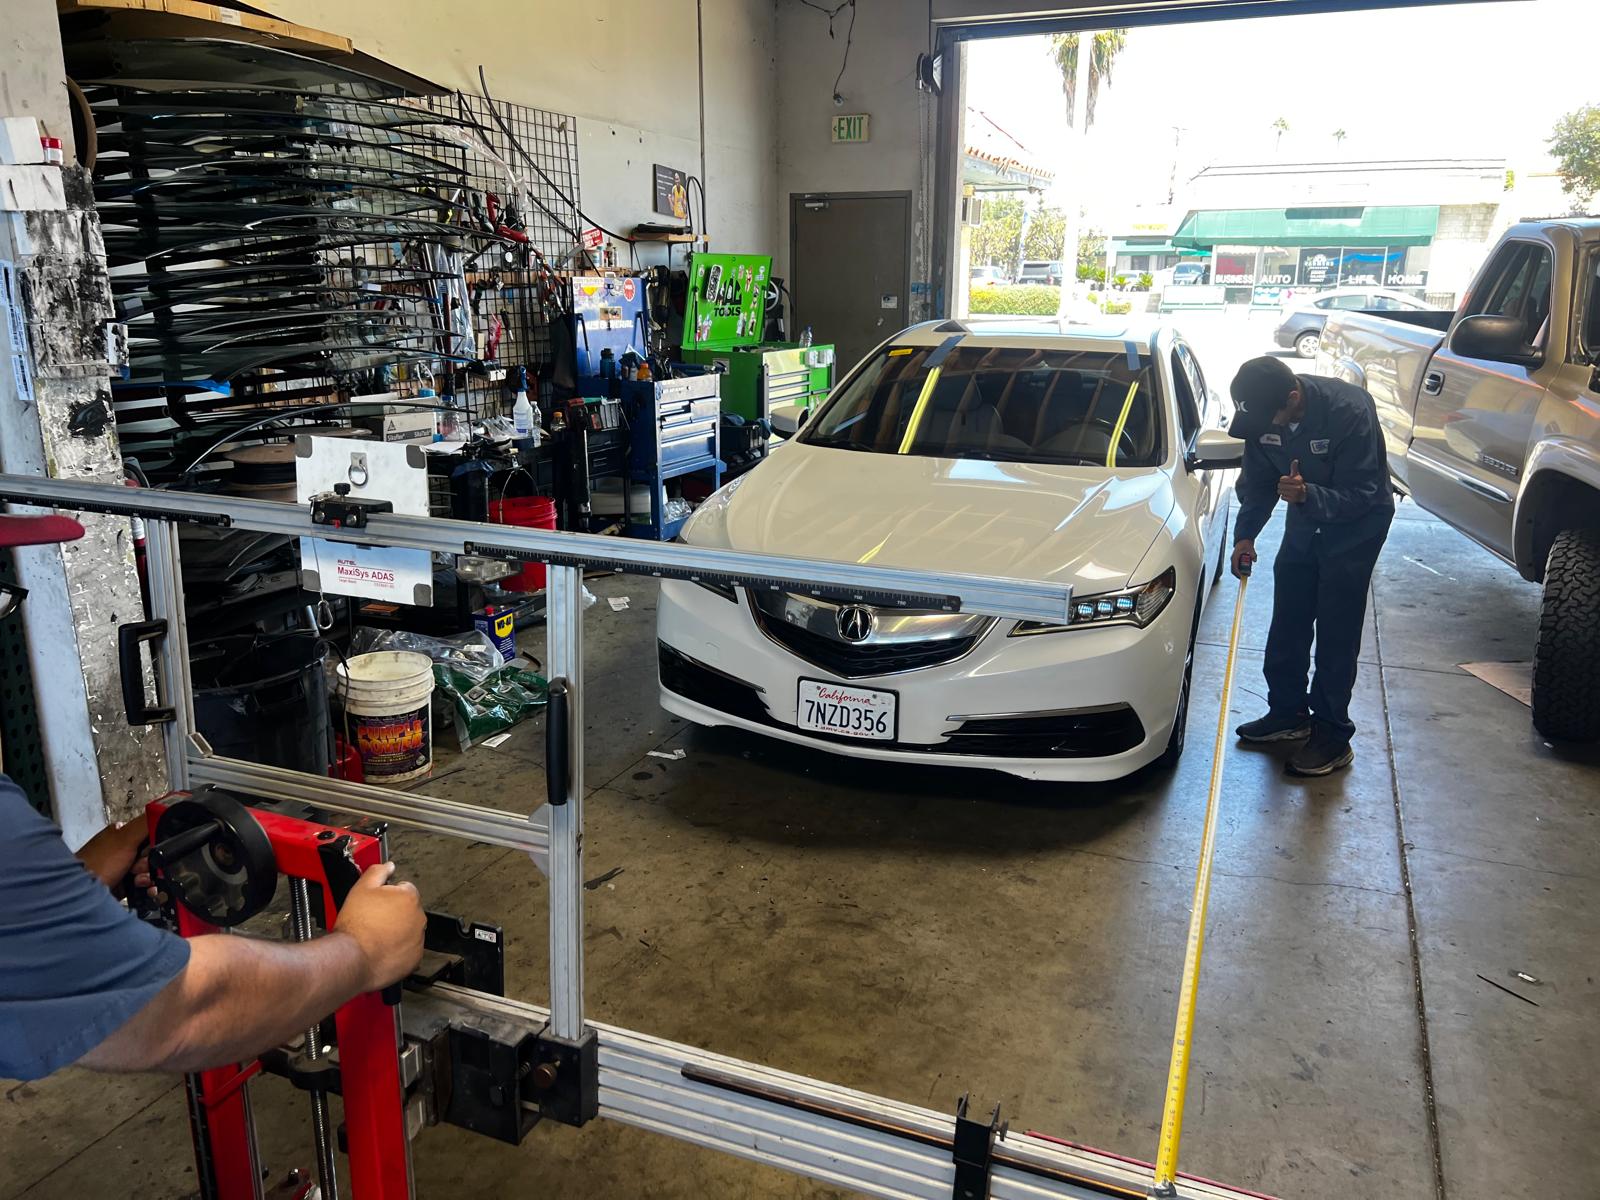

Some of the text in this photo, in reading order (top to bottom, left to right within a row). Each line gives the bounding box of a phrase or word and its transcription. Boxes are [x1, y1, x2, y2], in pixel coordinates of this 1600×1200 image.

[838, 116, 864, 140] EXIT
[1215, 273, 1254, 284] BUSINESS
[1260, 274, 1292, 284] AUTO
[1348, 274, 1376, 284] LIFE
[1387, 274, 1424, 285] HOME
[714, 306, 742, 317] TOOLS
[337, 566, 394, 582] MaxiSys ADAS
[819, 687, 876, 706] California
[805, 699, 888, 733] 7NZD356
[358, 720, 422, 740] PURPLE
[359, 732, 422, 754] POWER
